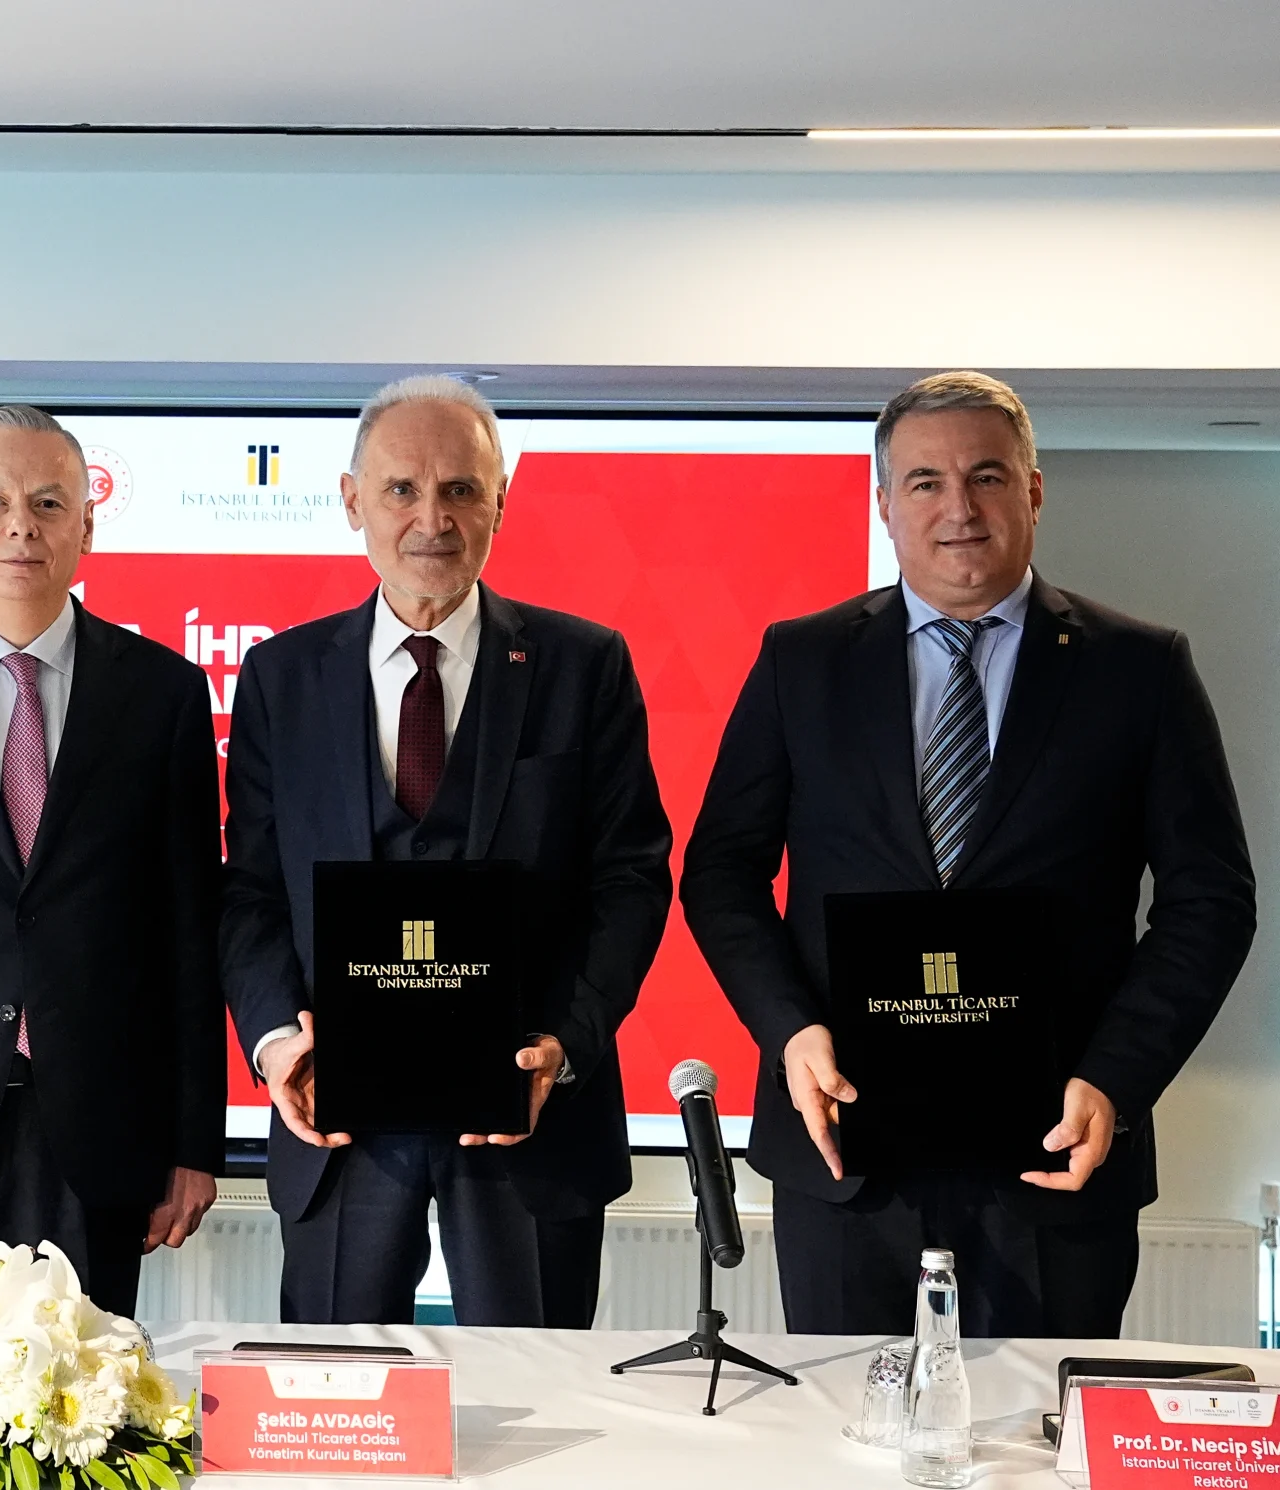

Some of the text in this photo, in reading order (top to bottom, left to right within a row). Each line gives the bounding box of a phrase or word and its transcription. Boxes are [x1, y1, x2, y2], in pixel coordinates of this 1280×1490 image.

[180, 490, 263, 506] İSTANBUL
[348, 962, 490, 976] İSTANBUL TİCARET
[377, 976, 462, 989] ÜNİVERSİTESİ
[868, 995, 1019, 1013] İSTANBUL TİCARET
[899, 1010, 990, 1025] ÜNİVERSİTESİ
[257, 1411, 395, 1433] Şekib AVDAGİÇ
[254, 1430, 400, 1446] İstanbul Ticaret Odası
[1113, 1434, 1157, 1450] Prof.
[1161, 1437, 1188, 1452] Dr.
[1192, 1437, 1248, 1459] Necip
[248, 1447, 406, 1464] Yönetim Kurulu Başkanı
[1122, 1454, 1180, 1470] İstanbul
[1183, 1458, 1232, 1472] Ticaret
[1194, 1475, 1249, 1489] Rektörü
